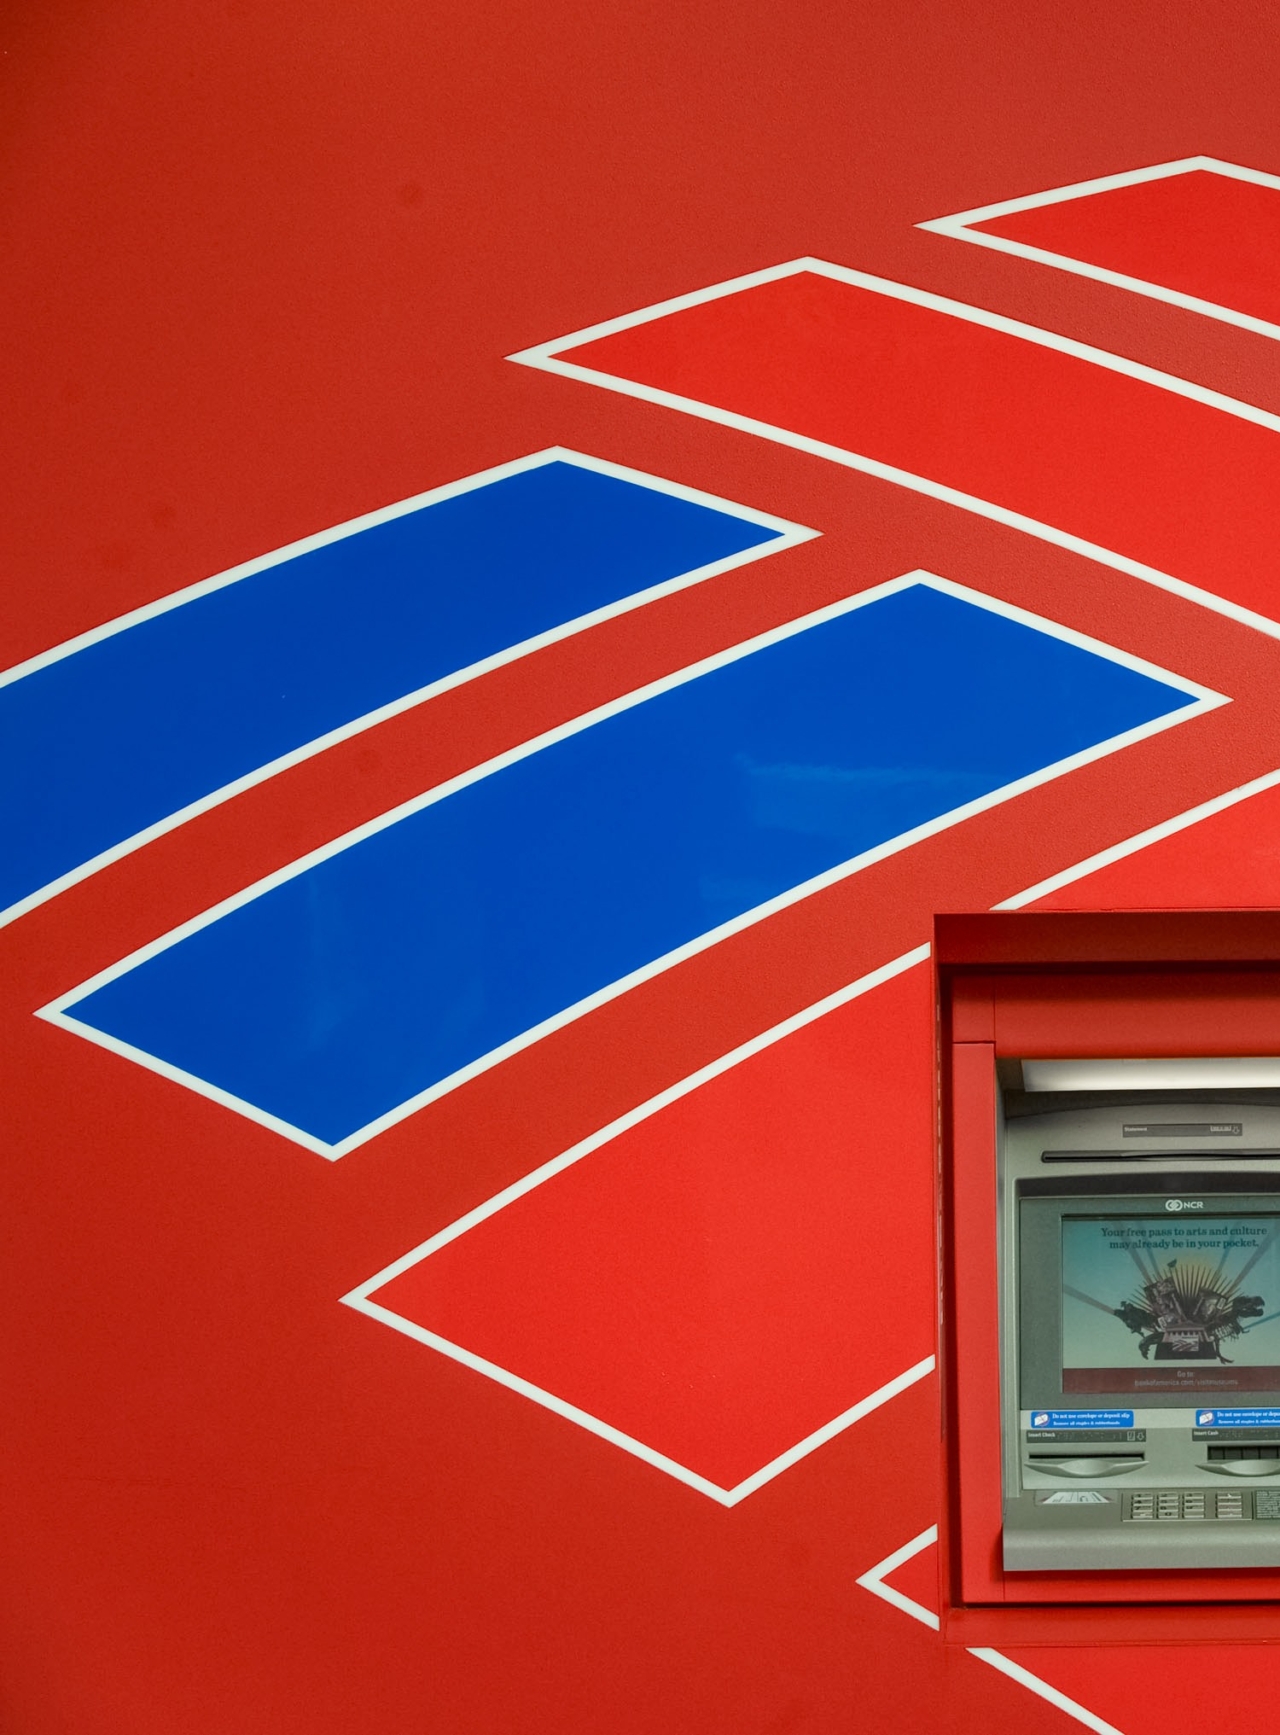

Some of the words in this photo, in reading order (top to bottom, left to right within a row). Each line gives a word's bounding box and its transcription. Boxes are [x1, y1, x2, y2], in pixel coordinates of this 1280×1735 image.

[1183, 1201, 1204, 1209] NCR
[1101, 1227, 1125, 1237] Your
[1127, 1227, 1147, 1237] free
[1148, 1229, 1173, 1238] pass
[1174, 1227, 1185, 1236] to
[1186, 1227, 1207, 1236] arts
[1209, 1227, 1228, 1236] and
[1230, 1226, 1267, 1236] culture
[1109, 1241, 1130, 1250] may
[1132, 1239, 1170, 1250] already
[1172, 1239, 1185, 1248] be
[1186, 1239, 1196, 1248] in
[1197, 1241, 1222, 1249] your
[1223, 1238, 1259, 1249] pocket.
